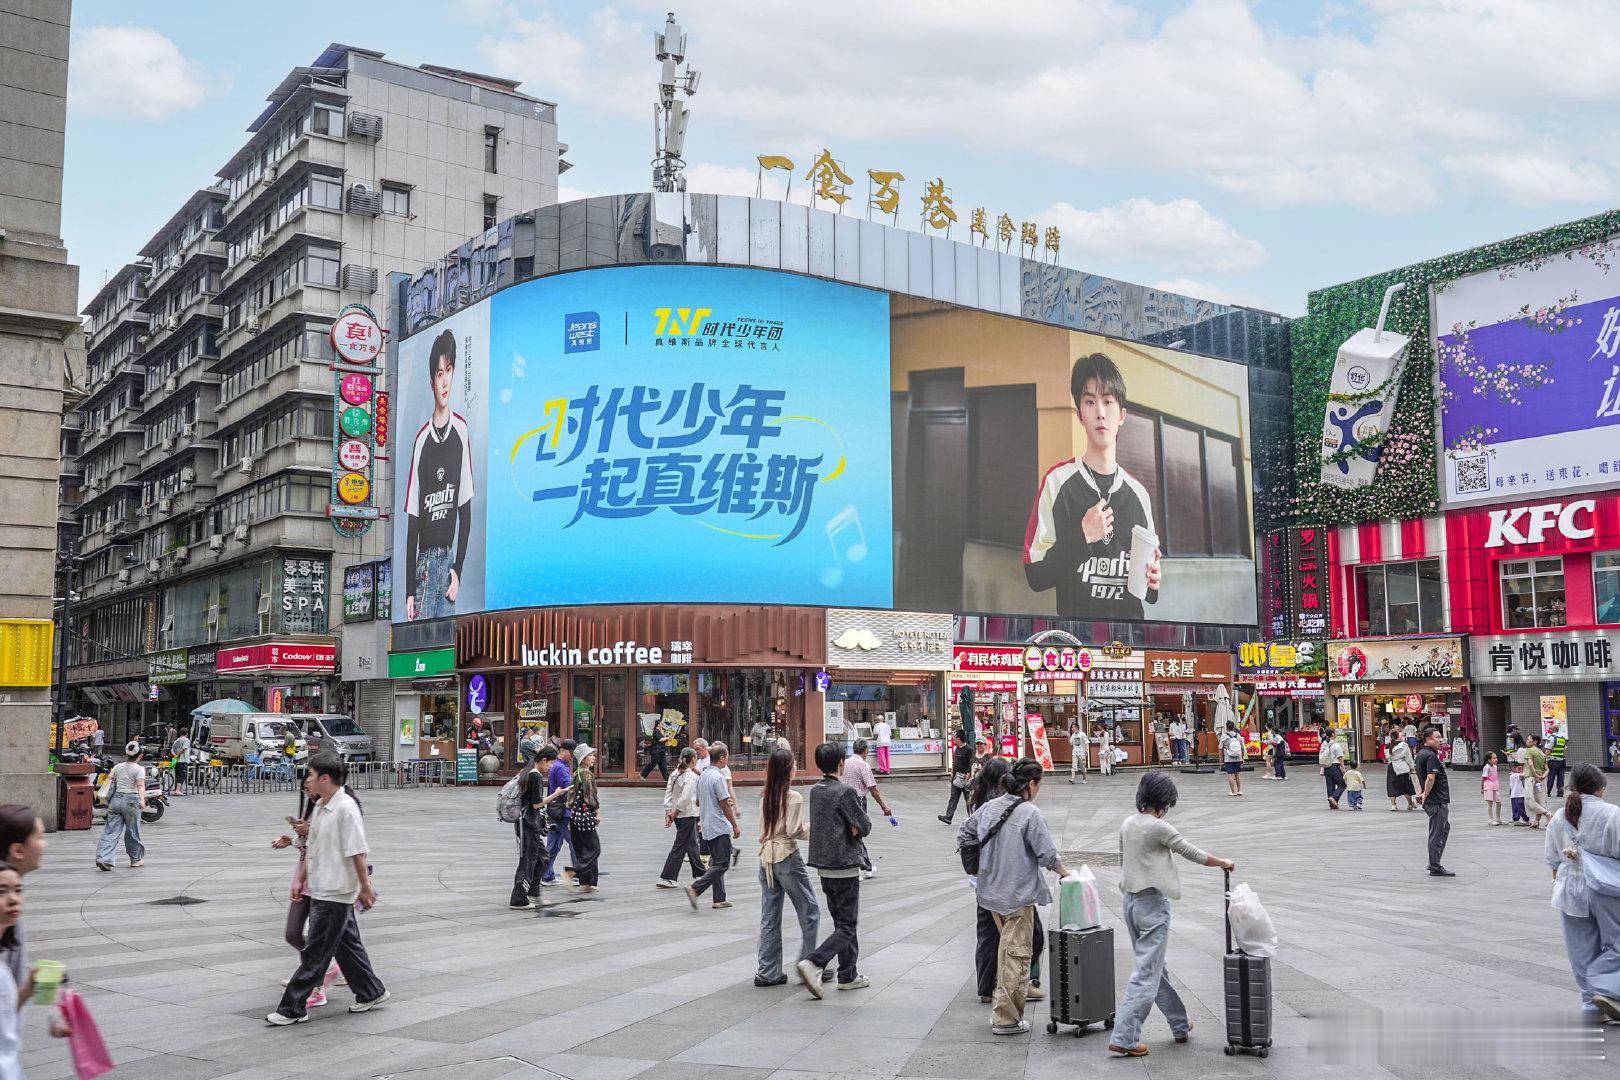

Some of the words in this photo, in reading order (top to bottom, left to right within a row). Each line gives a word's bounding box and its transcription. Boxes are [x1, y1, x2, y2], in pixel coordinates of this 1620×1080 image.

[757, 149, 957, 229] 一食万巷
[568, 322, 597, 332] Jeans
[702, 322, 783, 341] 时代少年团
[569, 331, 595, 340] west
[655, 337, 780, 352] 真维斯品牌全球代言人
[536, 382, 786, 467] 时代少年
[424, 484, 455, 512] sporty
[431, 509, 447, 521] 1972
[1485, 500, 1596, 548] KFC
[284, 560, 324, 577] 零零年
[1300, 529, 1319, 609] 罗二火锅
[1091, 585, 1124, 600] 1972
[283, 596, 324, 611] SPA
[521, 642, 582, 667] luckin
[588, 641, 663, 666] coffee
[671, 641, 693, 652] 瑞幸
[898, 641, 945, 653] 爷爷不泡茶
[271, 648, 279, 663] 超市
[282, 652, 312, 661] Codow
[671, 653, 693, 664] 咖啡
[967, 652, 1024, 667] 有民炸鸡腿
[1028, 650, 1091, 668] 一食万巷
[1488, 639, 1613, 672] 肯悦咖啡
[1151, 658, 1195, 678] 真茶屋
[1398, 661, 1452, 679] 茶颜悦色
